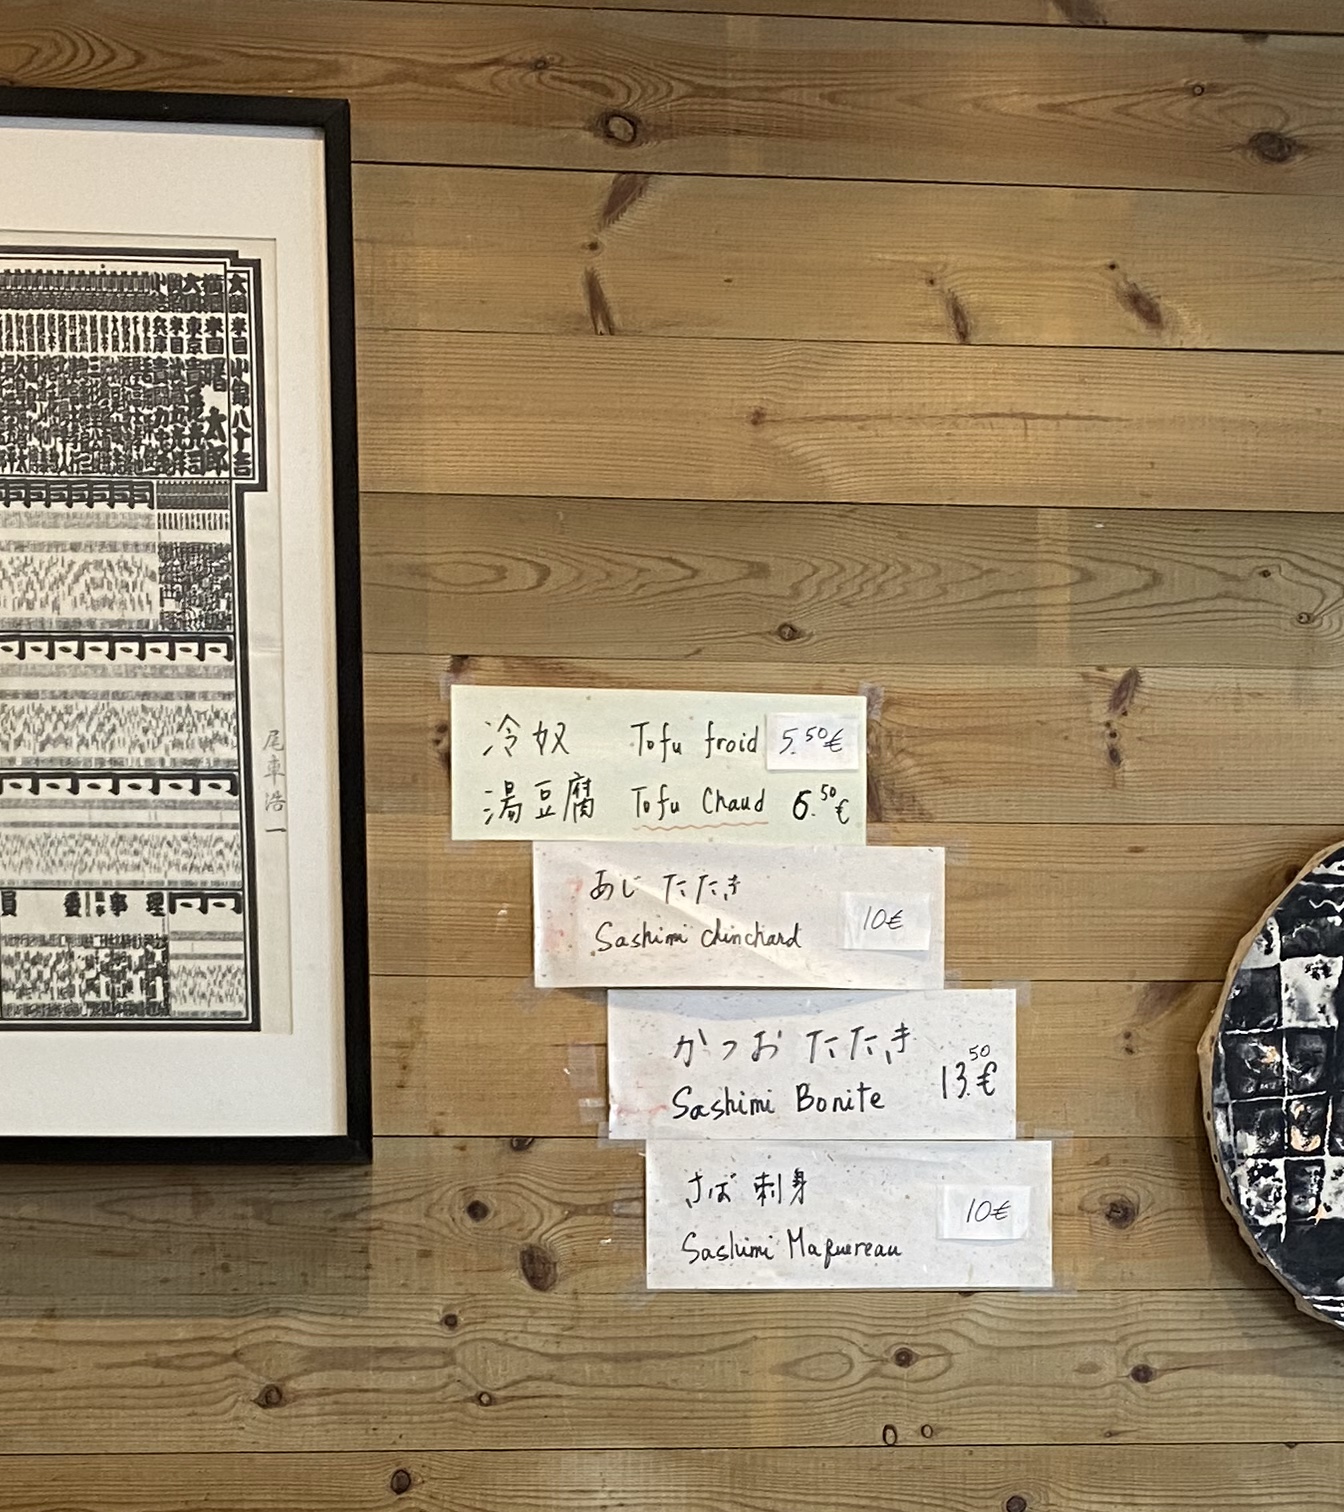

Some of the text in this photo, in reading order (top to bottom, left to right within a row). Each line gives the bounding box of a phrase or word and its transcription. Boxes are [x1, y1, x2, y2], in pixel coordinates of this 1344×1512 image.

[630, 721, 759, 758] Tofu froid
[483, 771, 594, 825] 湯豆腐
[631, 784, 680, 820] Tofu
[864, 906, 903, 930] 10€
[595, 921, 688, 952] Sashimi
[672, 1082, 885, 1120] Sashimi Bonite
[966, 1198, 1011, 1223] 10€
